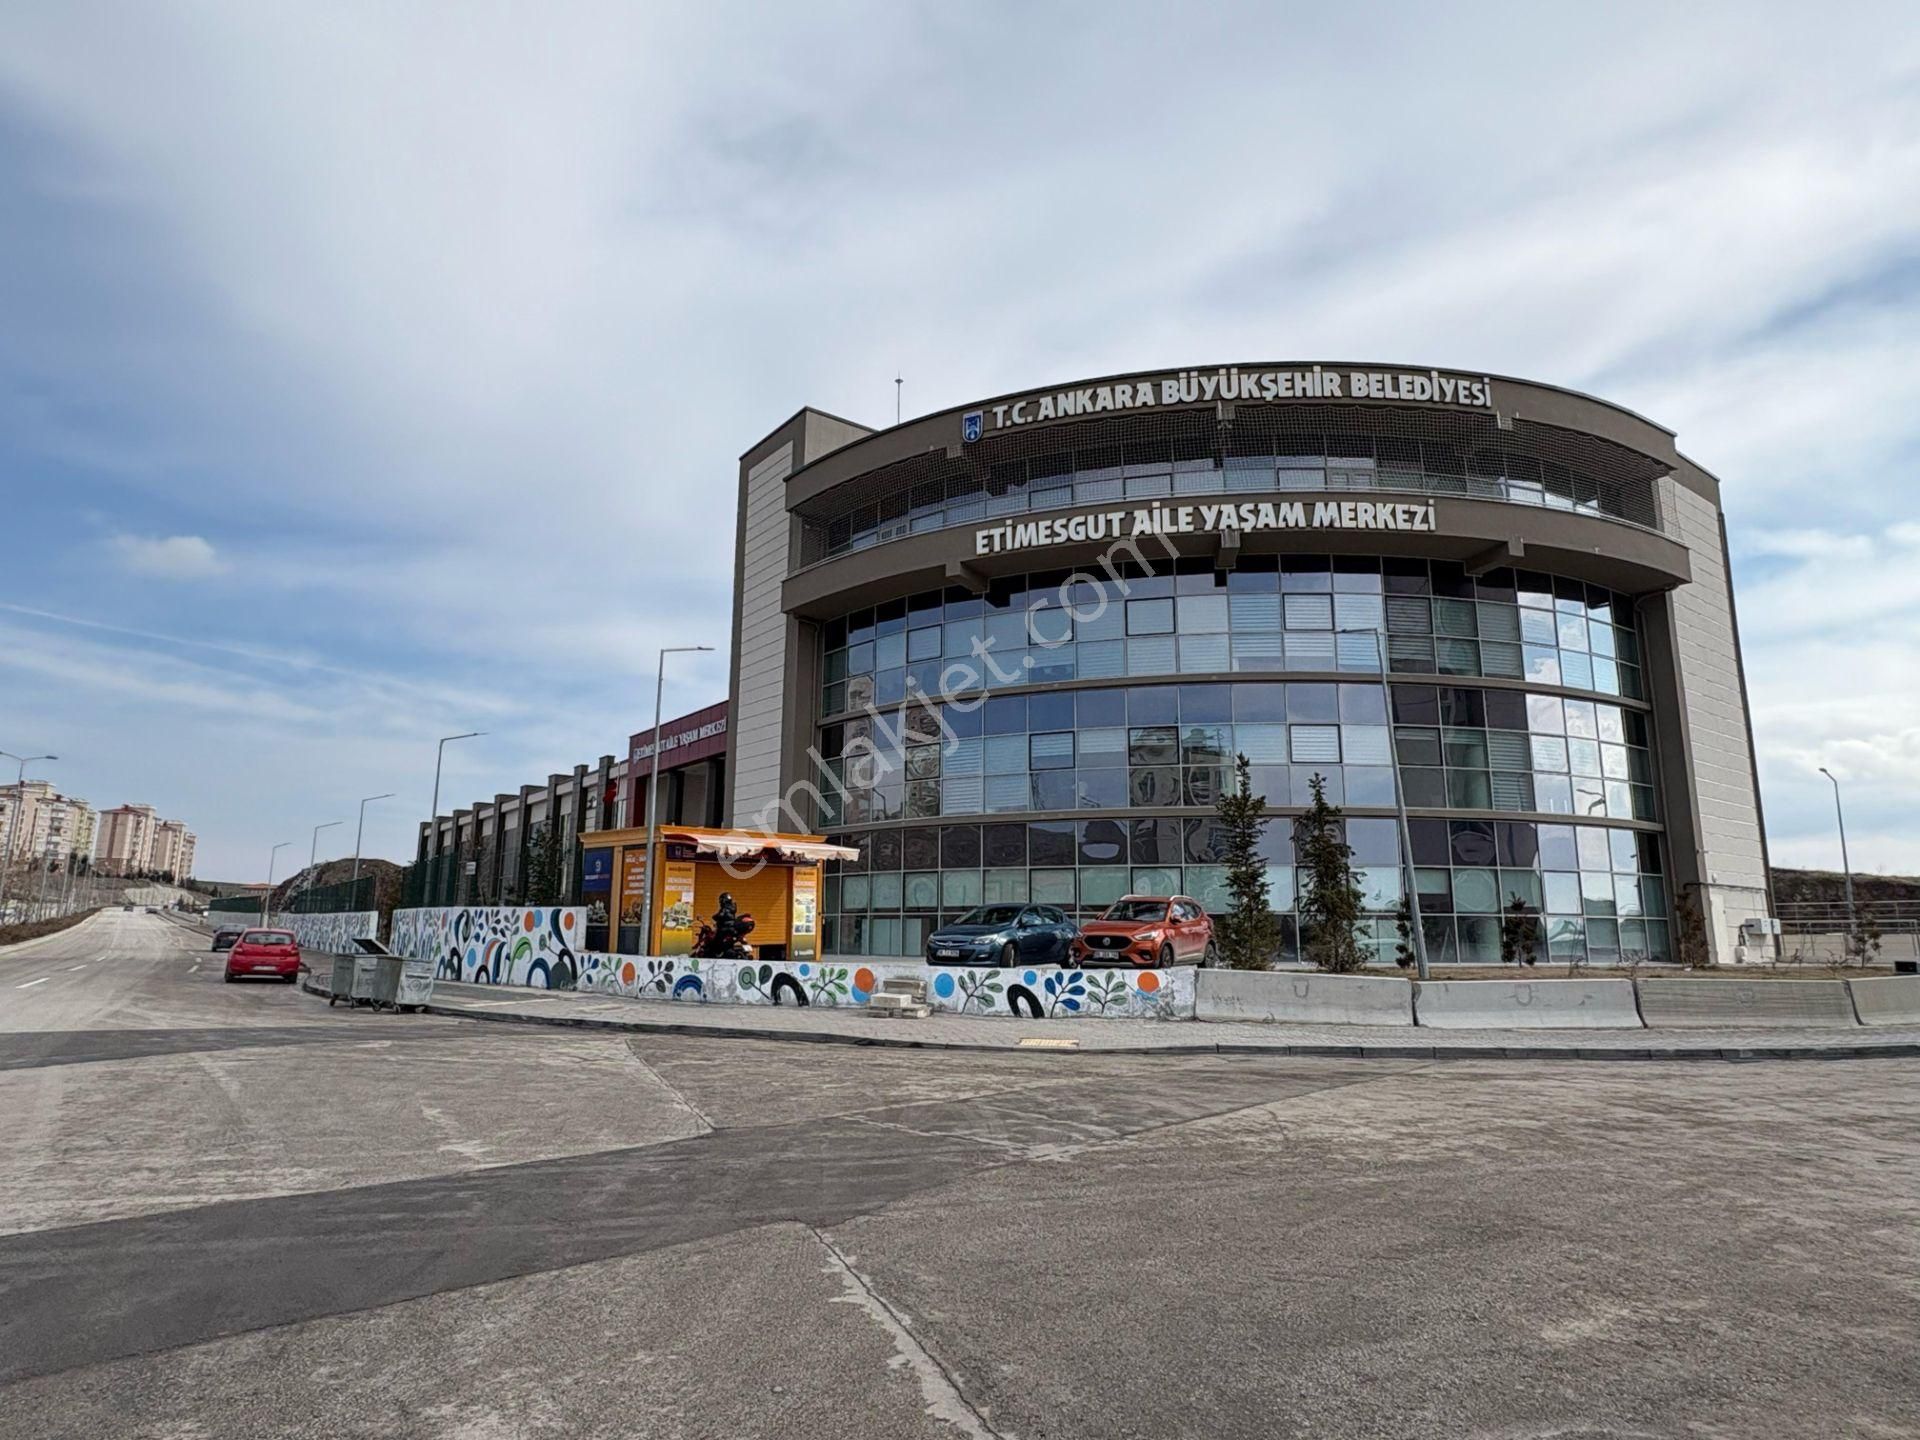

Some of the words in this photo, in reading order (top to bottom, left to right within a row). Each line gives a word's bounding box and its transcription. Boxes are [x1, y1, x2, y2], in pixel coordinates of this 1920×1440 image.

[992, 401, 1033, 429] T.C.
[1037, 382, 1156, 422] ANKARA
[1161, 365, 1343, 405] BÜYÜKŞEHİR
[1350, 370, 1492, 408] BELEDİYESİ
[975, 511, 1126, 556] ETİMESGUT
[1131, 501, 1195, 536] AİLE
[1200, 501, 1307, 533] YAŞAM
[1312, 498, 1436, 532] MERKEZİ
